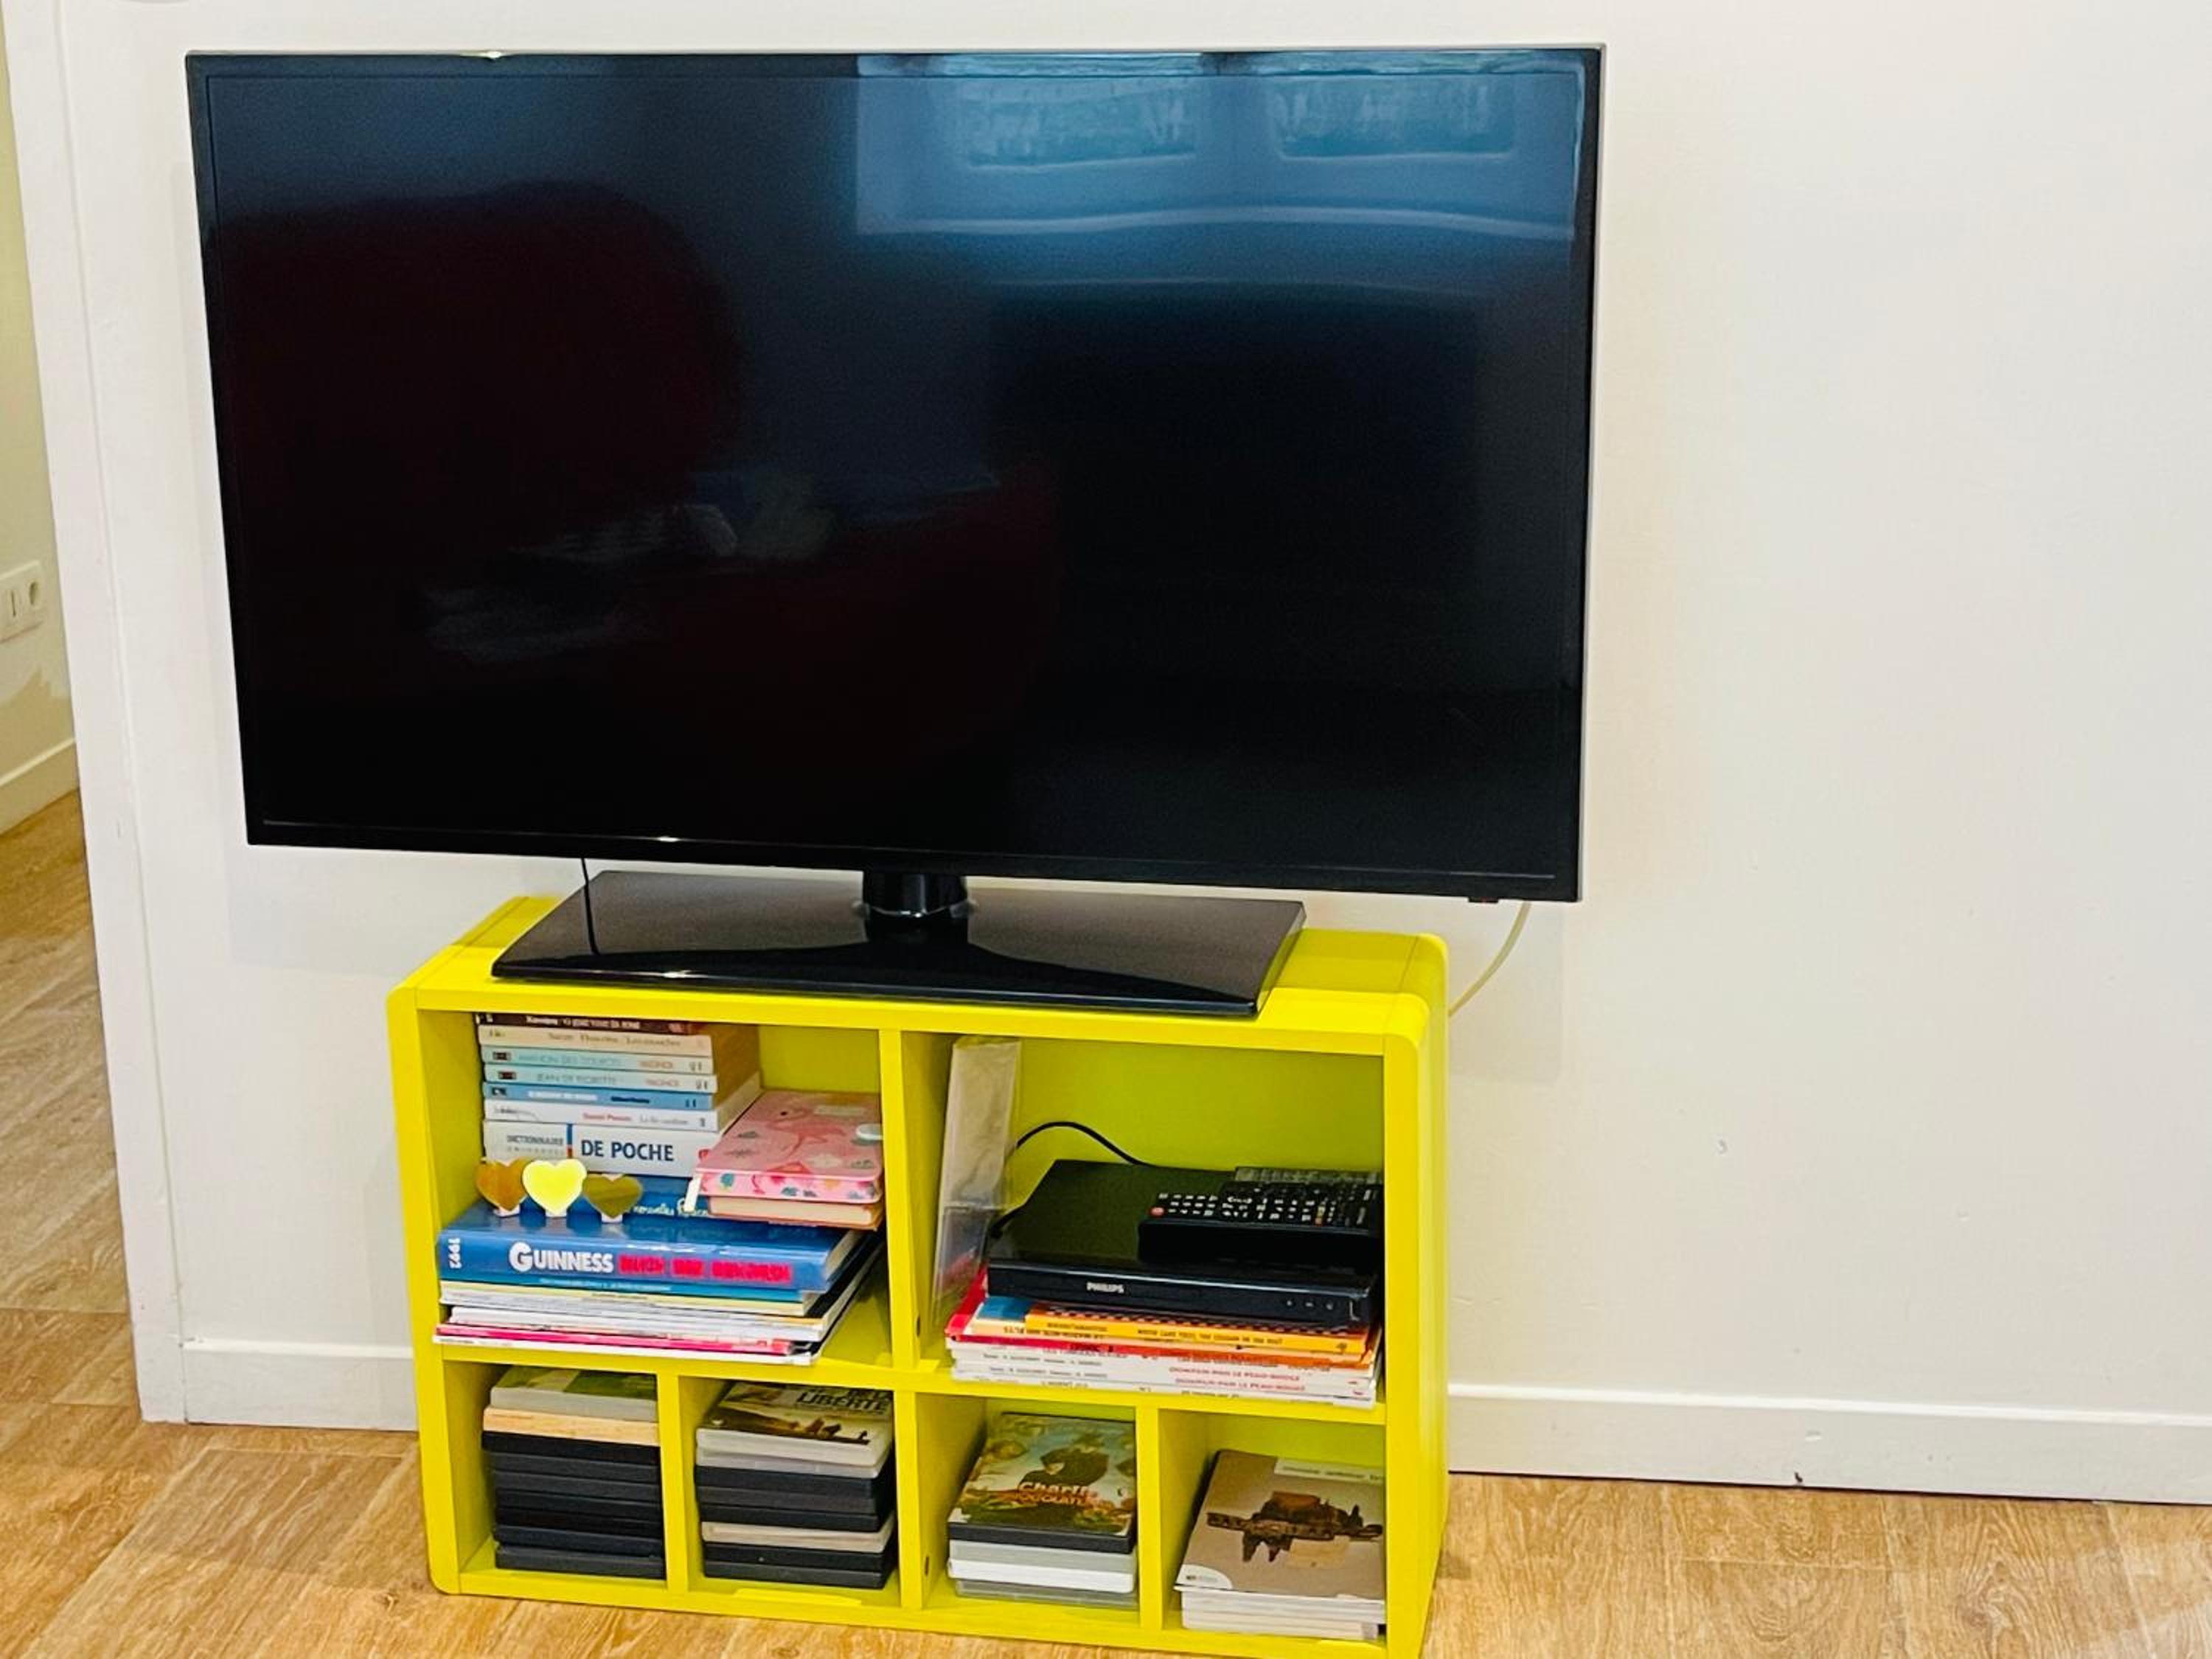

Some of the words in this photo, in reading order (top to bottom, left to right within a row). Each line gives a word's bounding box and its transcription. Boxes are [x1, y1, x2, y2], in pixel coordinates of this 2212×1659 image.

[581, 1139, 604, 1158] DE
[611, 1142, 674, 1161] POCHE
[509, 1241, 614, 1274] GUINNESS
[1086, 1281, 1124, 1293] PHILIPS
